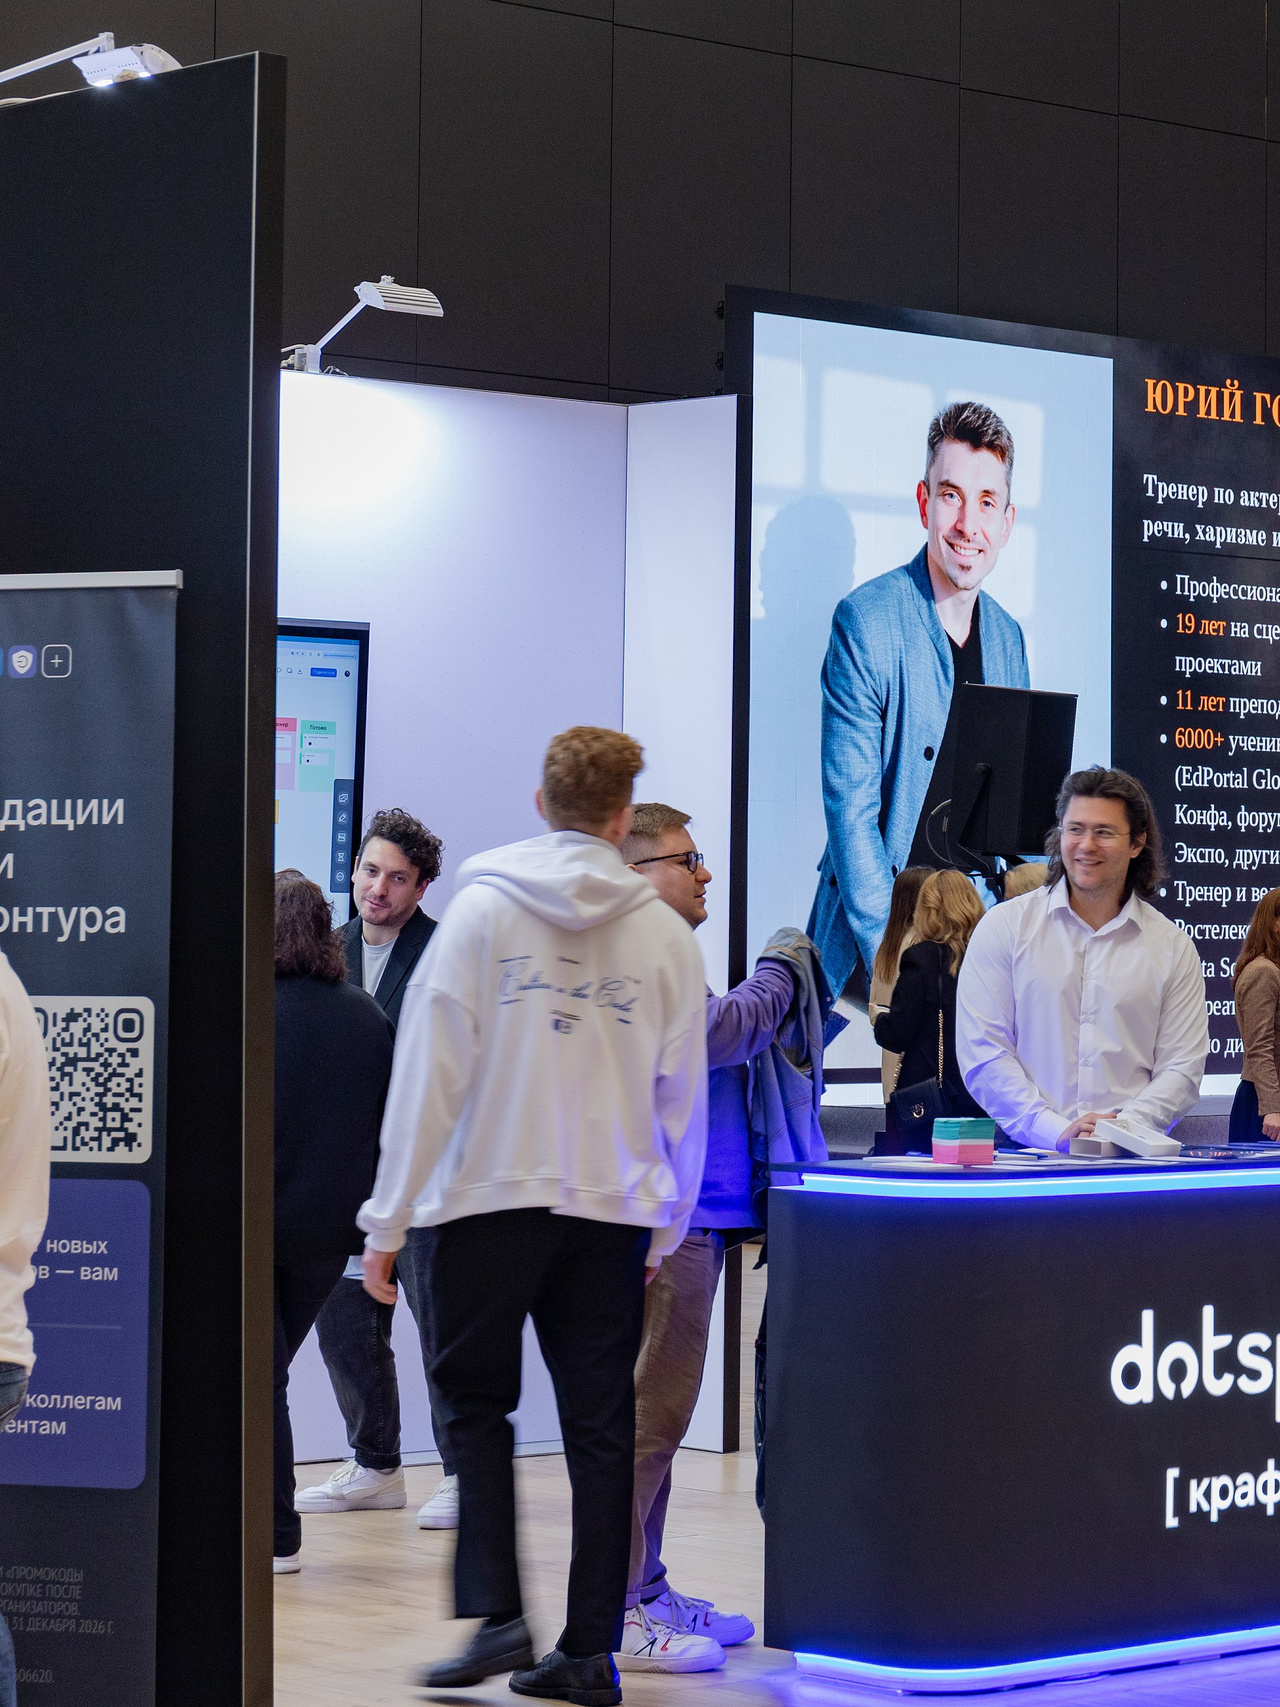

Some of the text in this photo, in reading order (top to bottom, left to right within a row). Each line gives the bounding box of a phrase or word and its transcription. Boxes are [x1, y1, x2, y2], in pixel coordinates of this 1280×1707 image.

[1144, 378, 1244, 423] ЮРИЙ
[1143, 473, 1208, 509] Тренер
[1213, 487, 1235, 505] по
[1142, 519, 1191, 545] речи,
[1194, 524, 1267, 549] харизме
[1176, 612, 1196, 634] 19
[1198, 619, 1227, 636] лет
[1230, 621, 1250, 638] на
[1174, 655, 1262, 678] проектами
[1176, 689, 1194, 710] 11
[1197, 695, 1226, 712] лет
[1175, 727, 1225, 750] 6000+
[1174, 765, 1249, 792] (EdPortal
[1174, 803, 1233, 831] Конфа,
[1174, 841, 1230, 868] Экспо,
[1173, 880, 1232, 908] Тренер
[1235, 886, 1247, 902] и
[1175, 919, 1250, 940] Ростелек
[46, 1239, 109, 1255] новых
[80, 1266, 119, 1281] вам
[25, 1393, 122, 1411] коллегам
[0, 1419, 67, 1435] ентам
[46, 1584, 82, 1599] ПОСЛЕ
[12, 1616, 24, 1631] 31
[26, 1617, 76, 1632] ДЕКАБРЯ
[79, 1619, 106, 1634] 2026
[15, 1668, 54, 1683] 06620.
